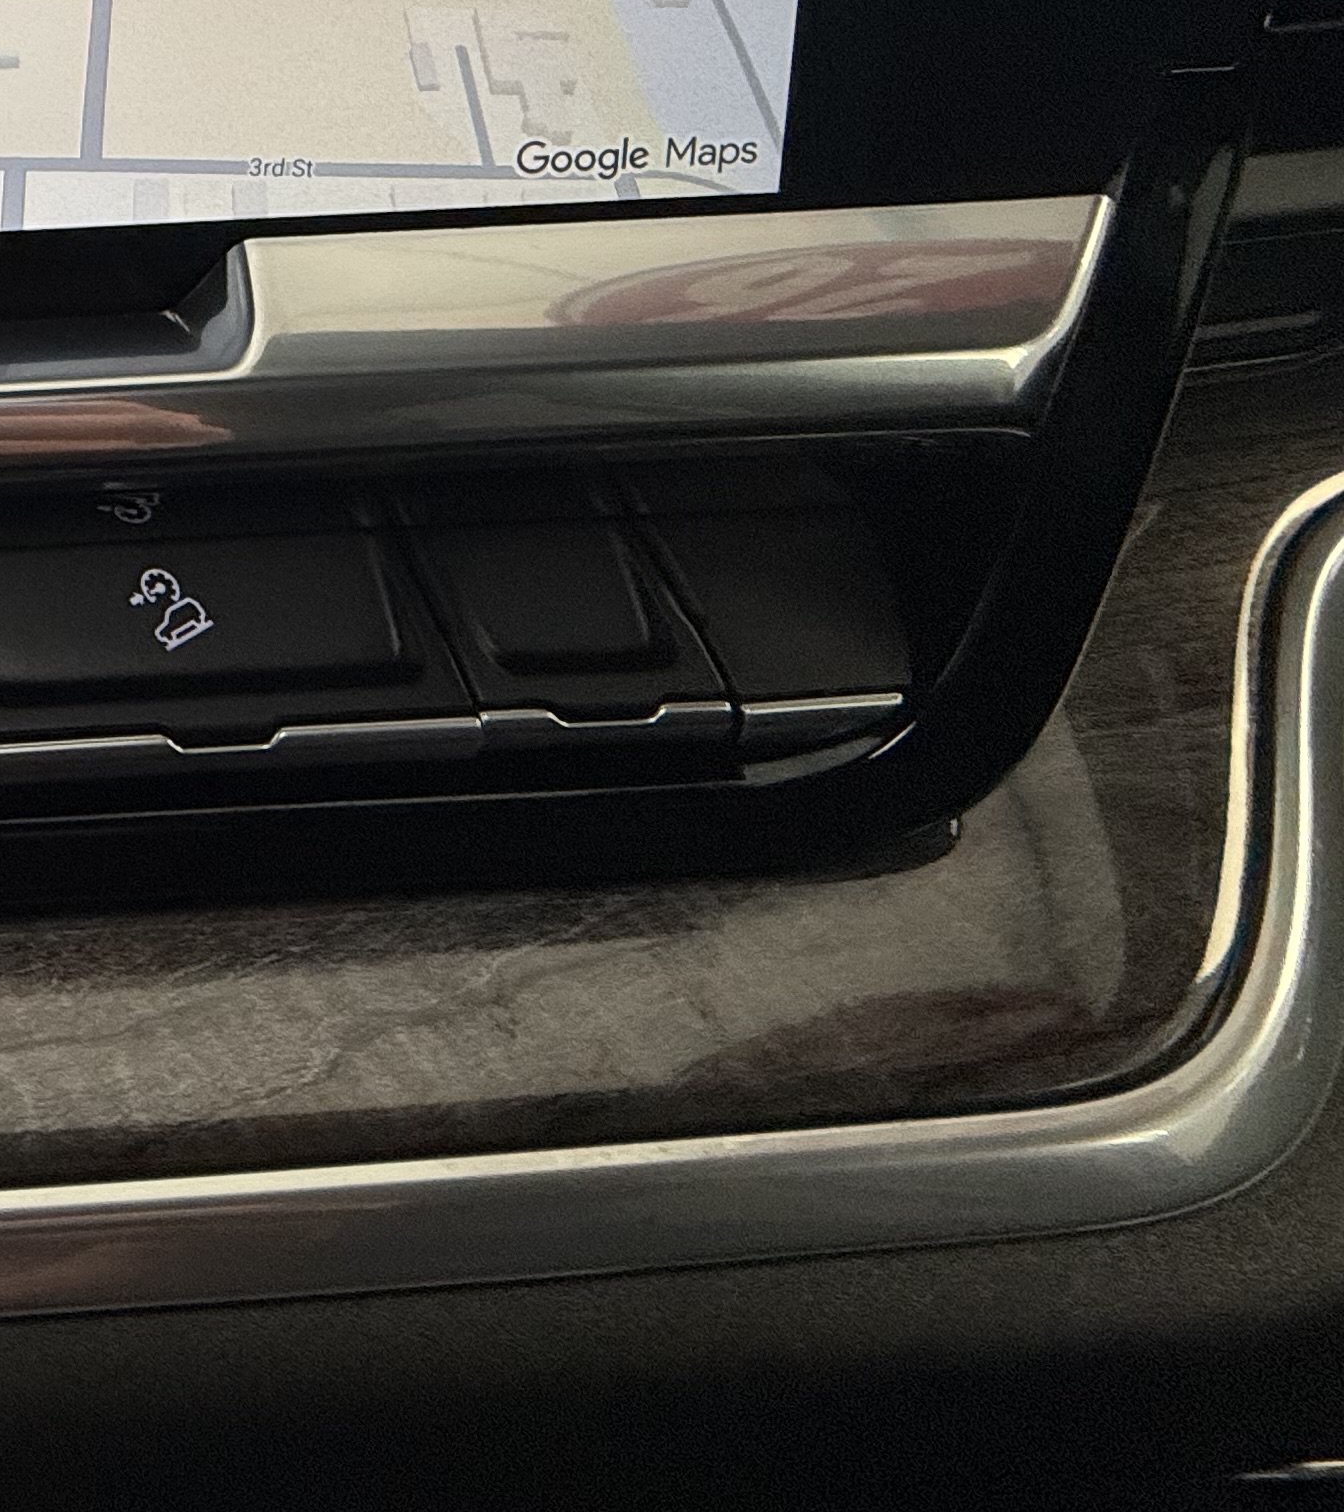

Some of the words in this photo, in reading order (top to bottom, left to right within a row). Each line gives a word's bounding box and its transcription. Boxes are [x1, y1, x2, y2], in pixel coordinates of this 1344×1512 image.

[249, 157, 286, 177] 3rd
[292, 158, 313, 178] St
[516, 137, 649, 180] Google
[665, 136, 758, 173] Maps
